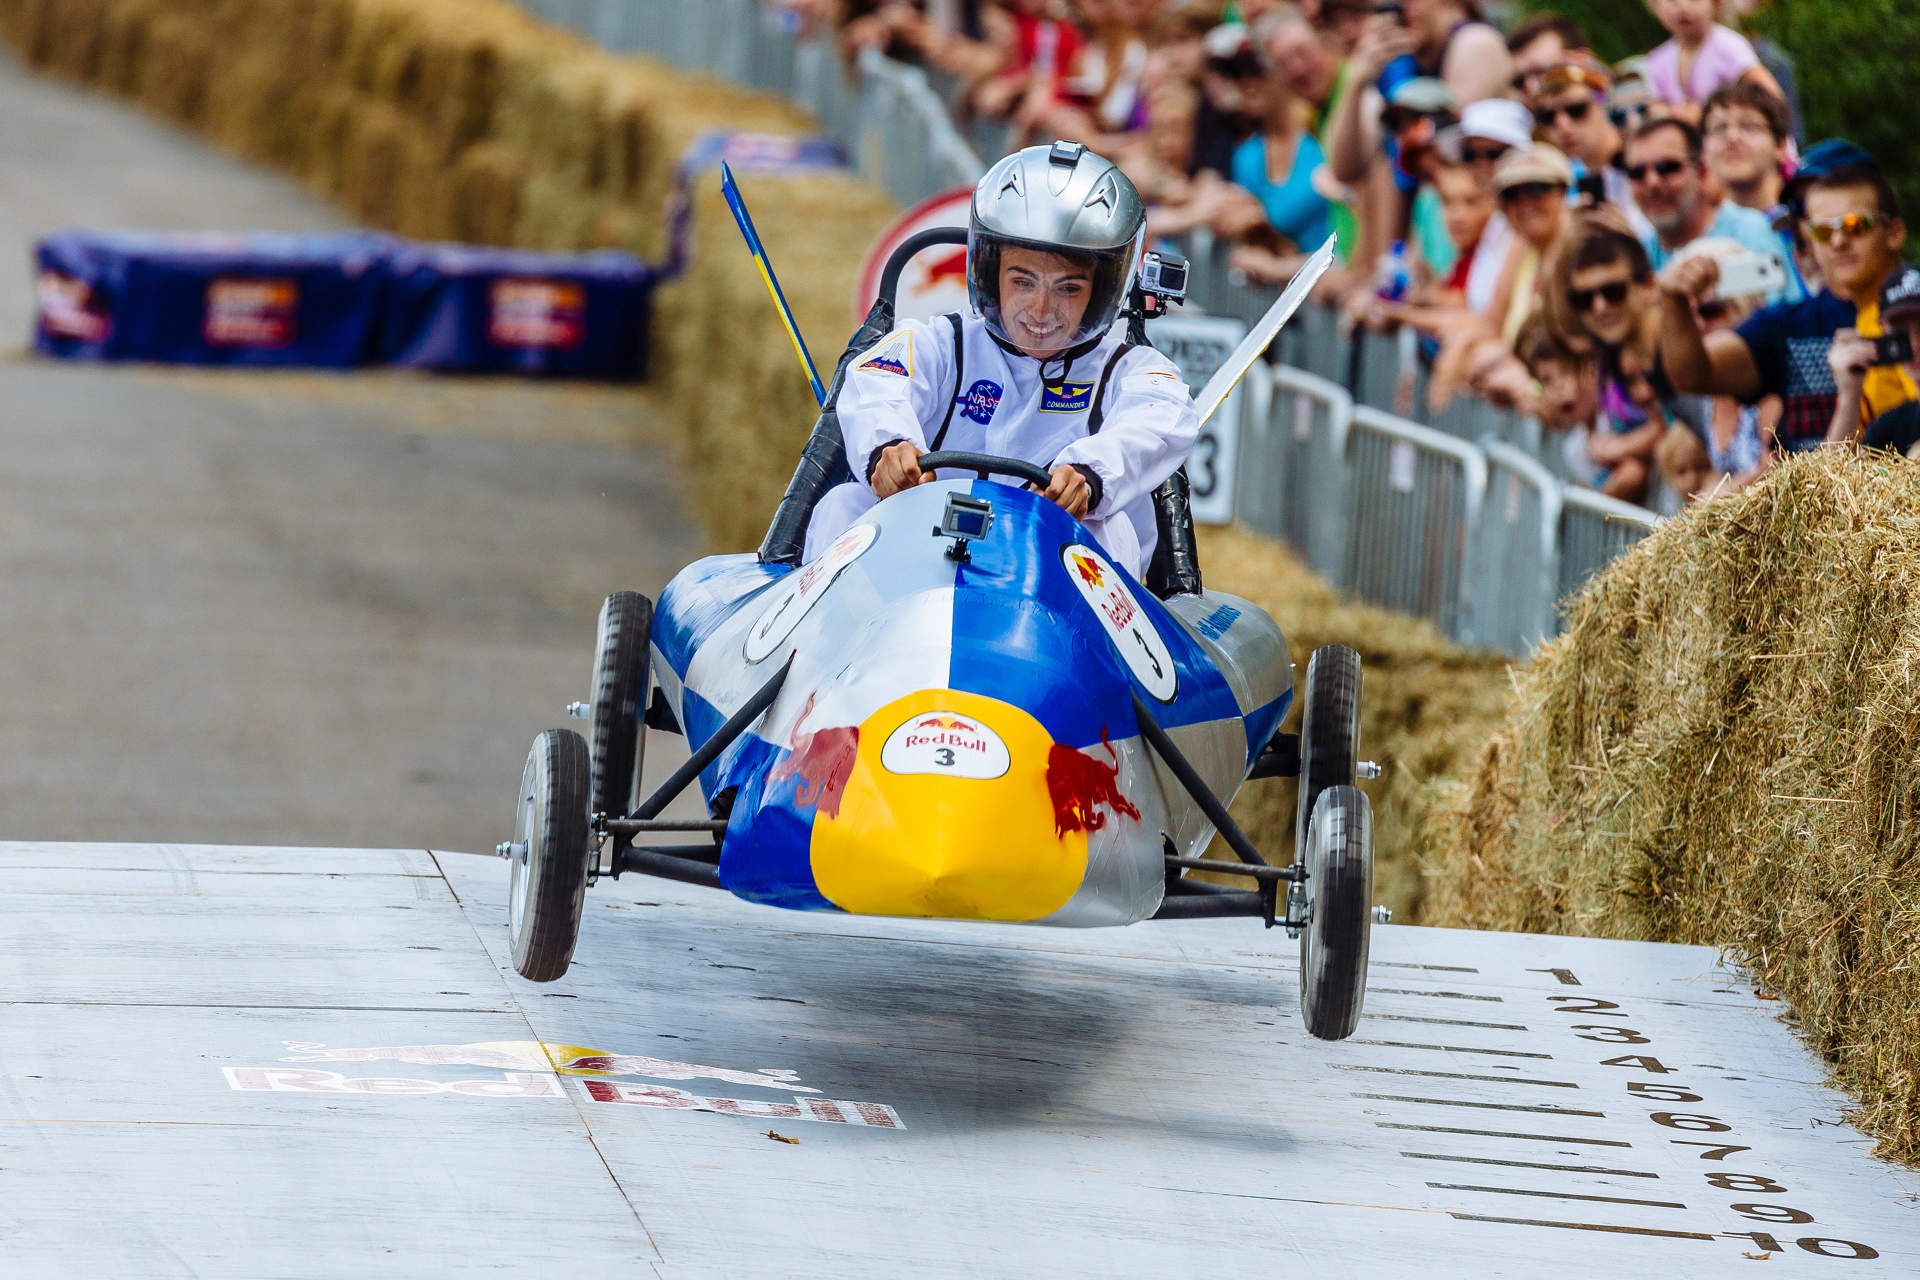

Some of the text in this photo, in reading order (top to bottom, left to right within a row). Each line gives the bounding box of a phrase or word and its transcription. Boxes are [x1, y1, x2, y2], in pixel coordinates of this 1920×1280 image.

[1046, 400, 1086, 409] COMMANDER
[1132, 627, 1164, 680] 3
[905, 733, 987, 753] Red Bull
[934, 747, 956, 767] 3
[1525, 968, 1582, 986] 1
[1546, 996, 1629, 1018] 2
[1570, 1025, 1651, 1044] 3
[1599, 1055, 1679, 1074] 4
[222, 1067, 906, 1130] Red Bull
[1627, 1081, 1704, 1103] 5
[1650, 1111, 1732, 1132] 6
[1669, 1139, 1752, 1161] 7
[1704, 1172, 1788, 1193] 8
[1729, 1203, 1815, 1224] 9
[1722, 1231, 1880, 1260] 10
